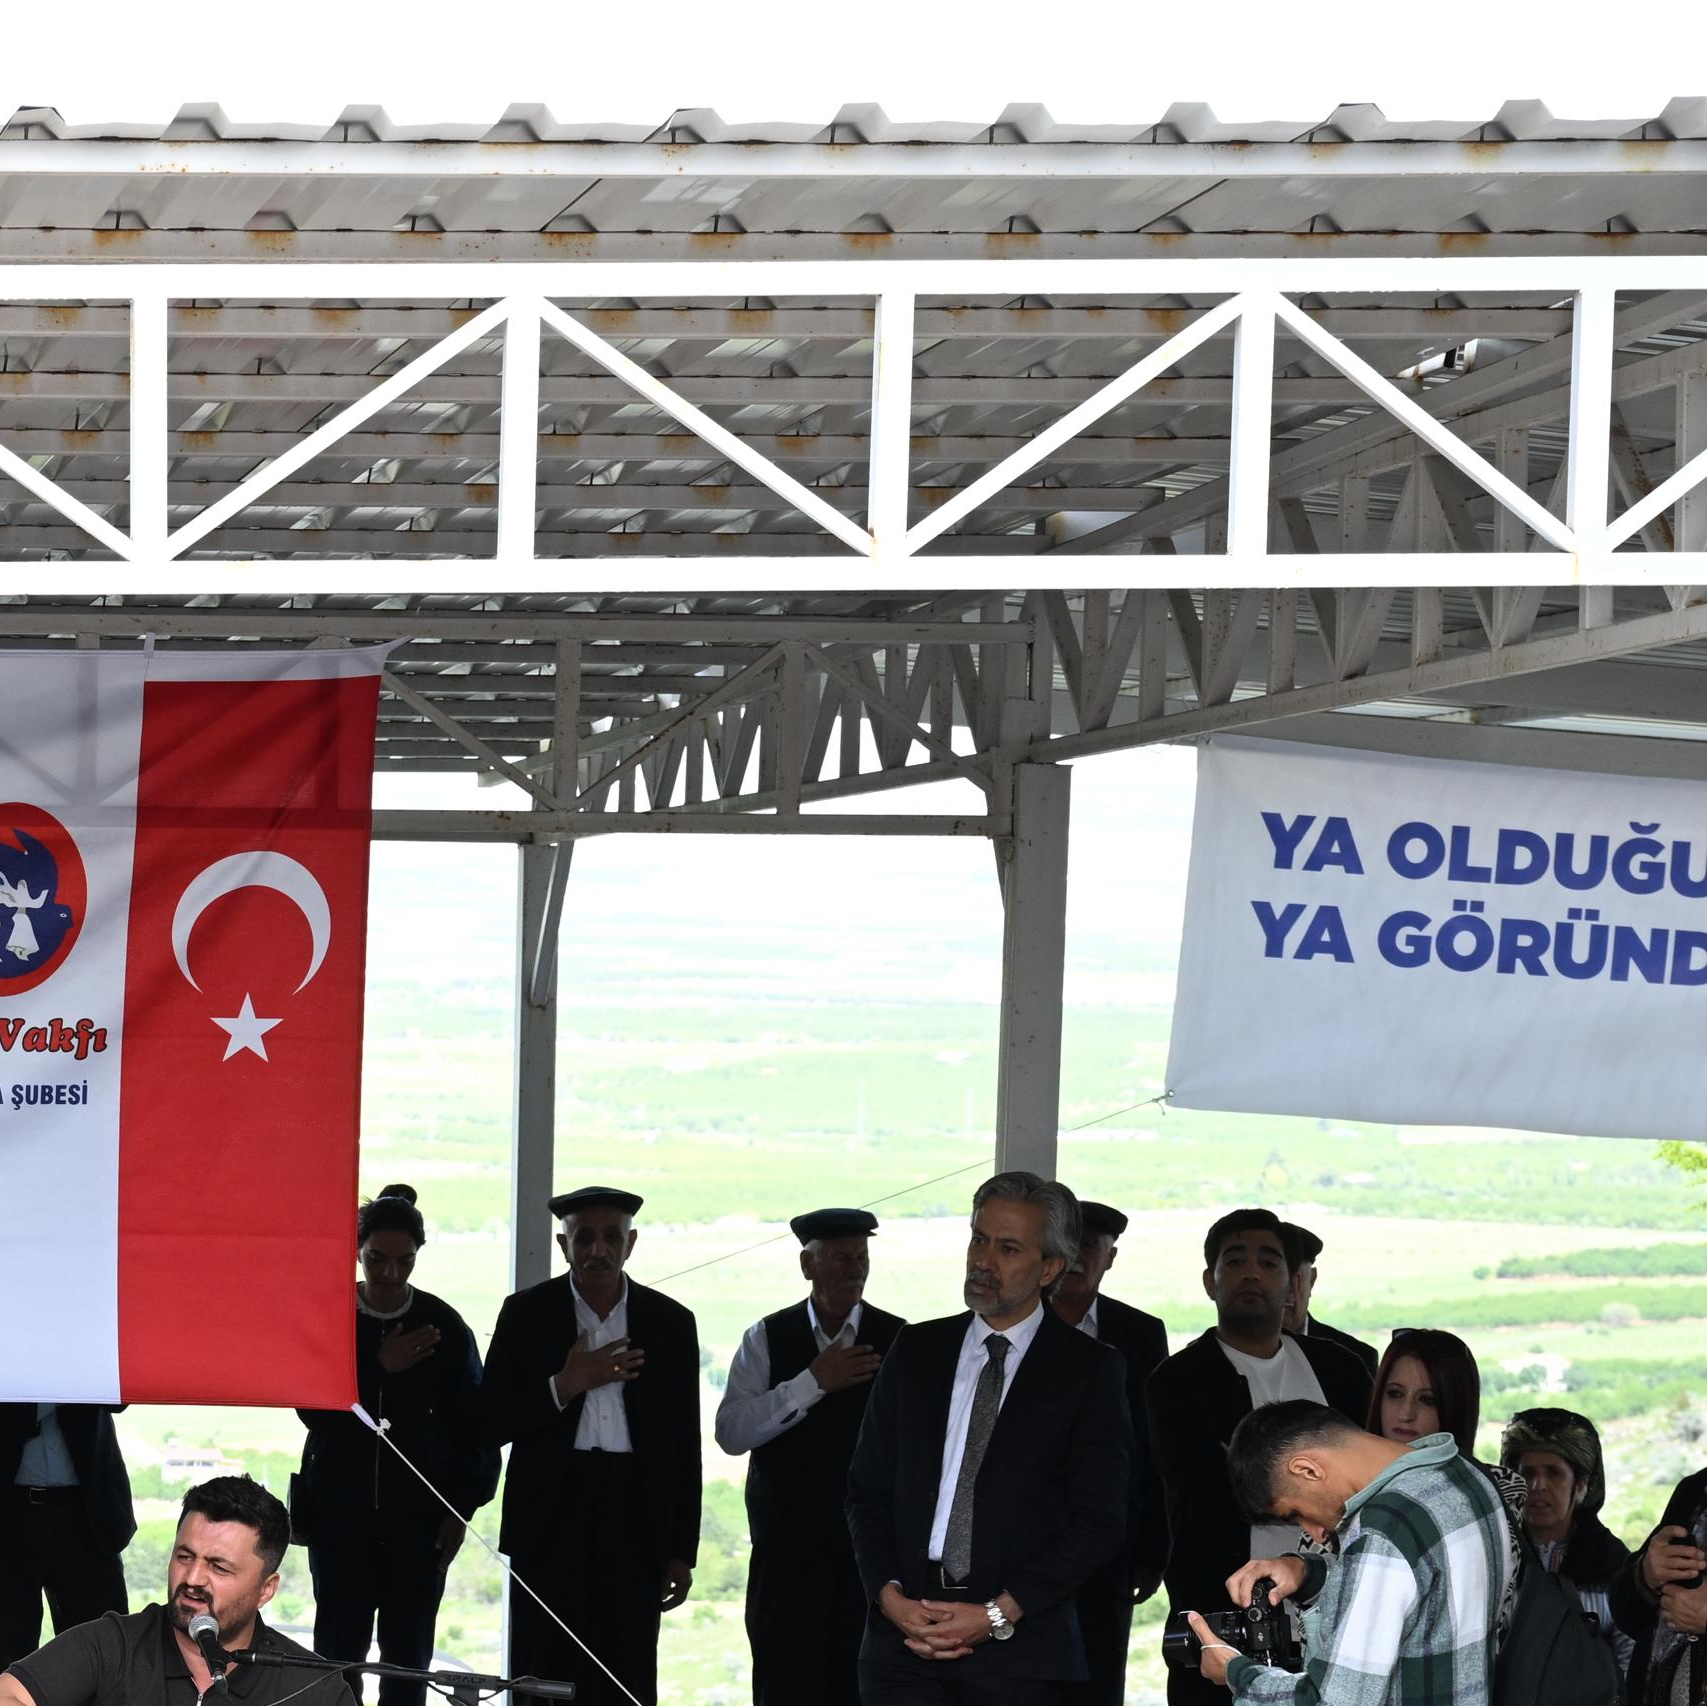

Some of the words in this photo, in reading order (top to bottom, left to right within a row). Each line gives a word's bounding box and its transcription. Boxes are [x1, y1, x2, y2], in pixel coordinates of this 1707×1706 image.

[1261, 811, 1364, 875] YA
[1251, 901, 1355, 963] YA
[11, 1079, 89, 1111] ŞUBESİ
